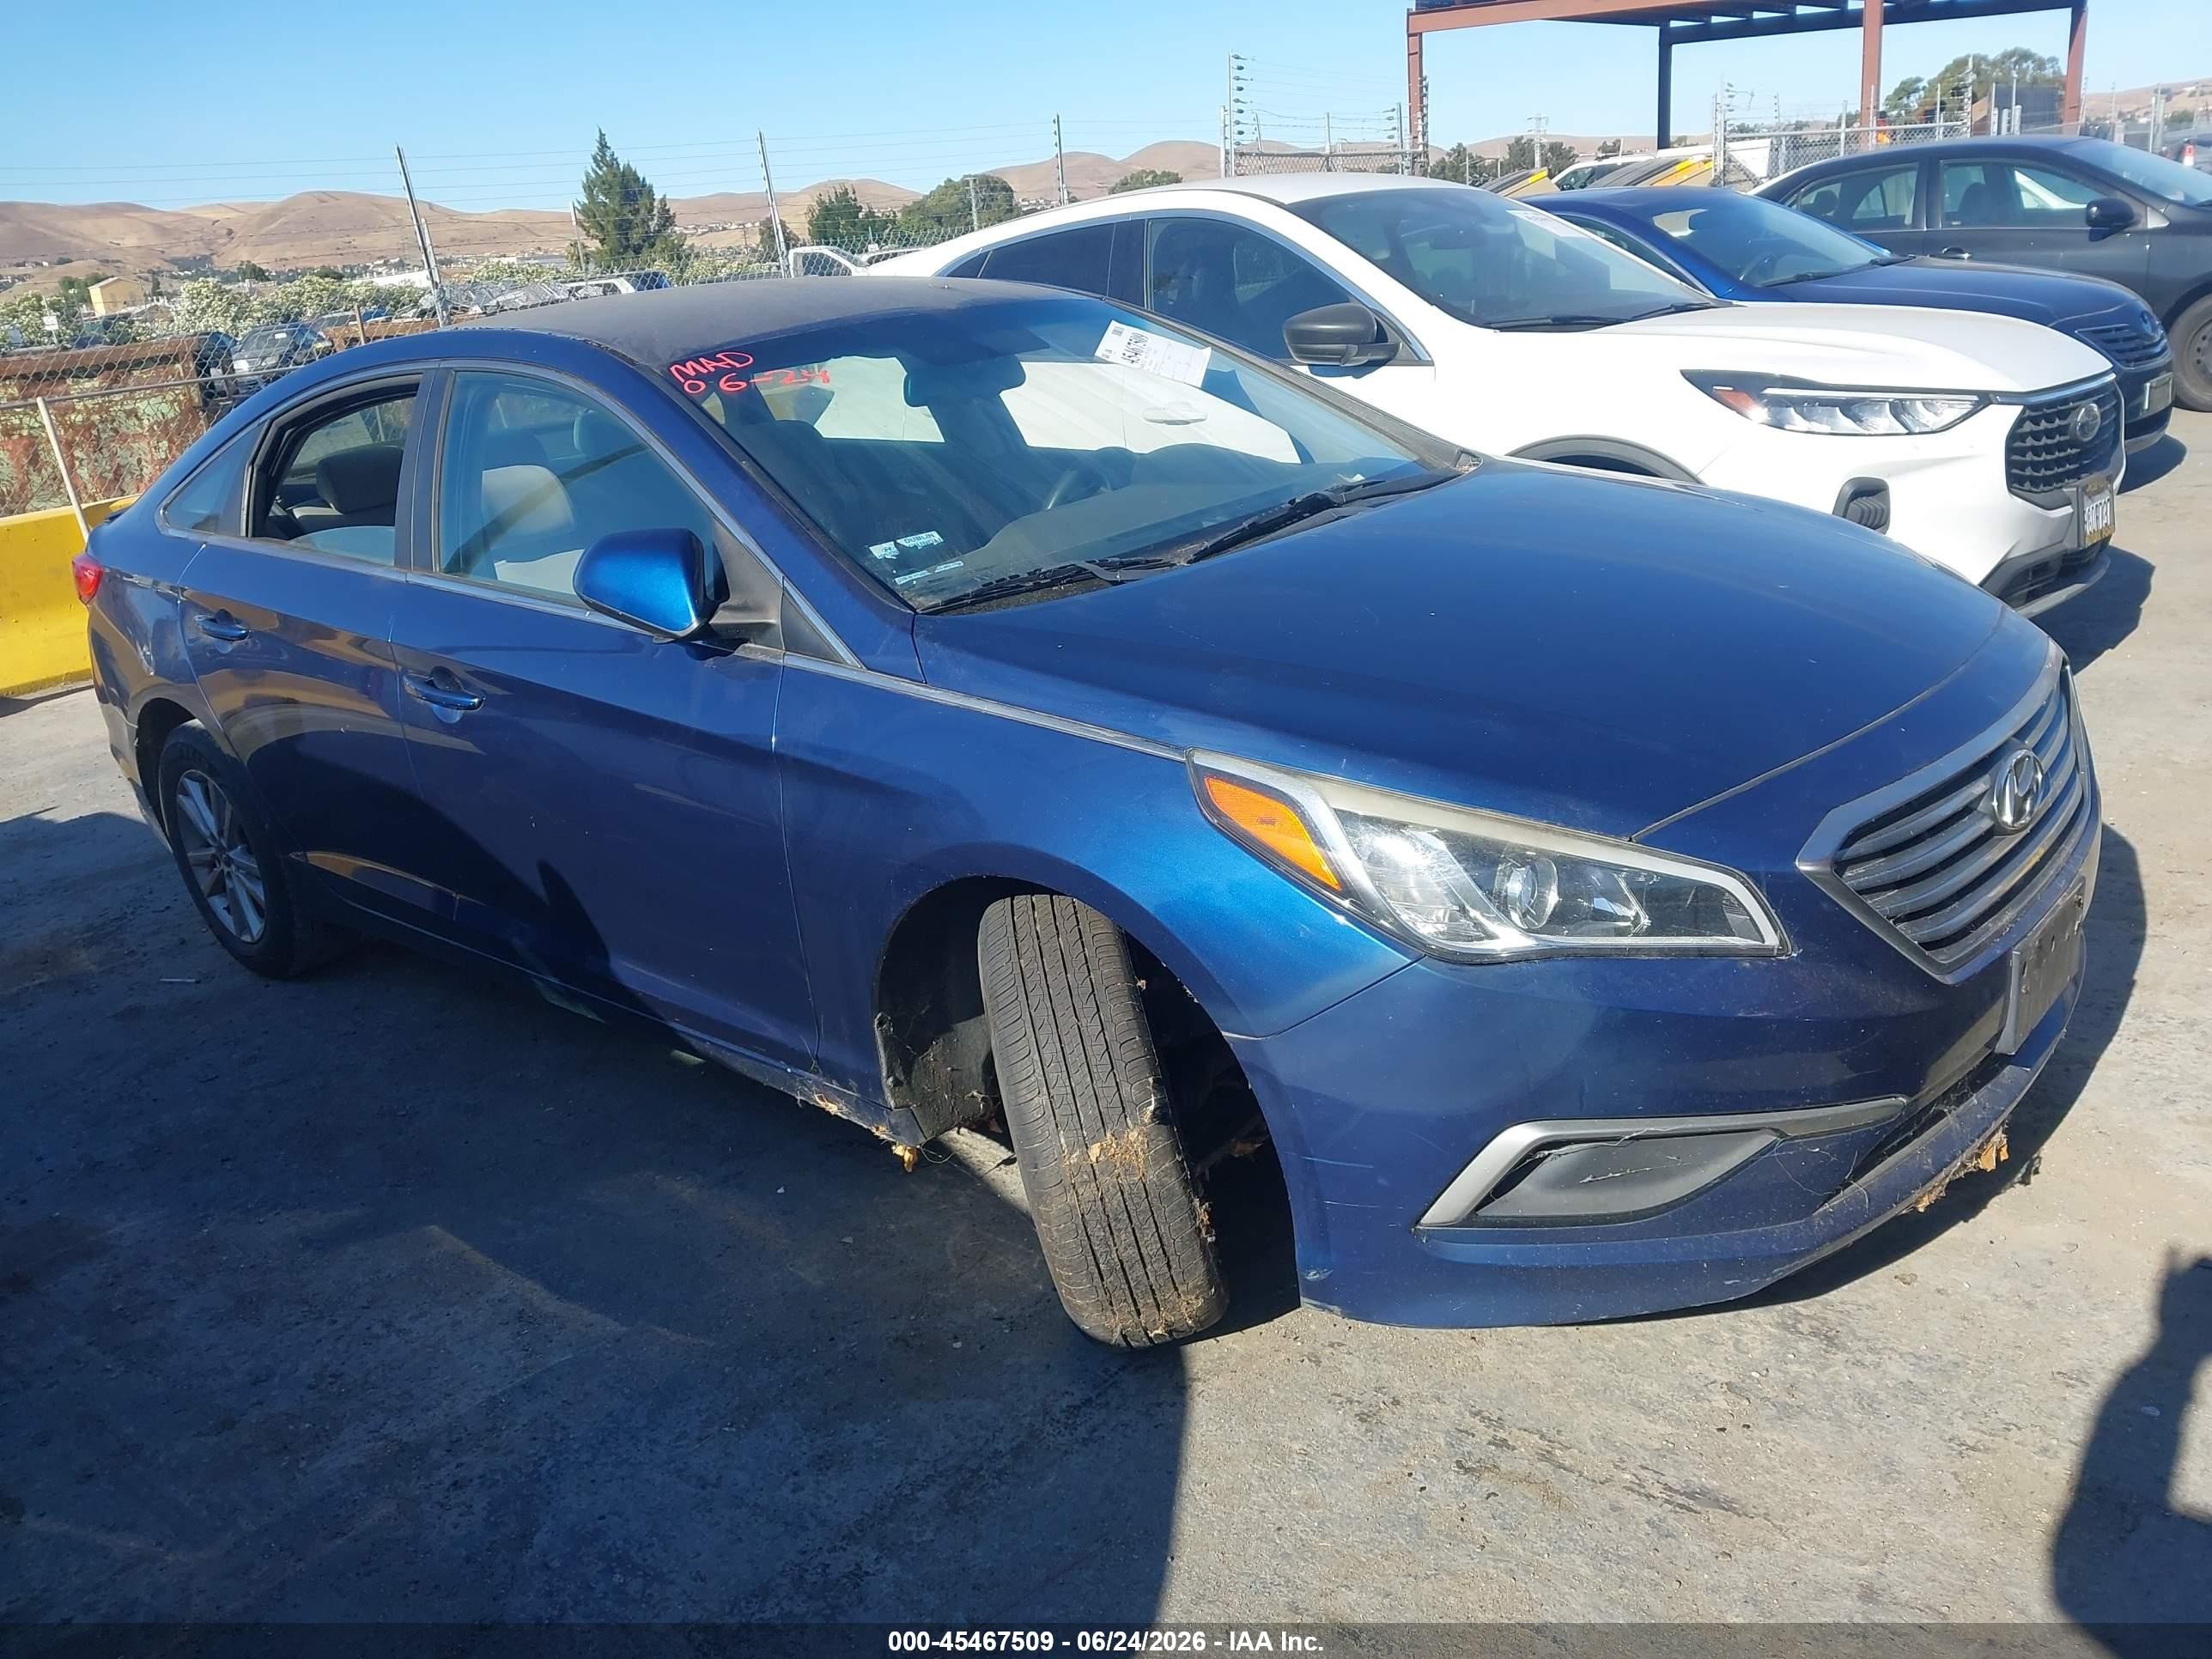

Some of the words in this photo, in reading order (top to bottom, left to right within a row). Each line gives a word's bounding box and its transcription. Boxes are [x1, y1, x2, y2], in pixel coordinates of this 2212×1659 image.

[1121, 331, 1150, 364] 45467509
[670, 351, 754, 383] MAD
[903, 533, 936, 544] DUBLIN
